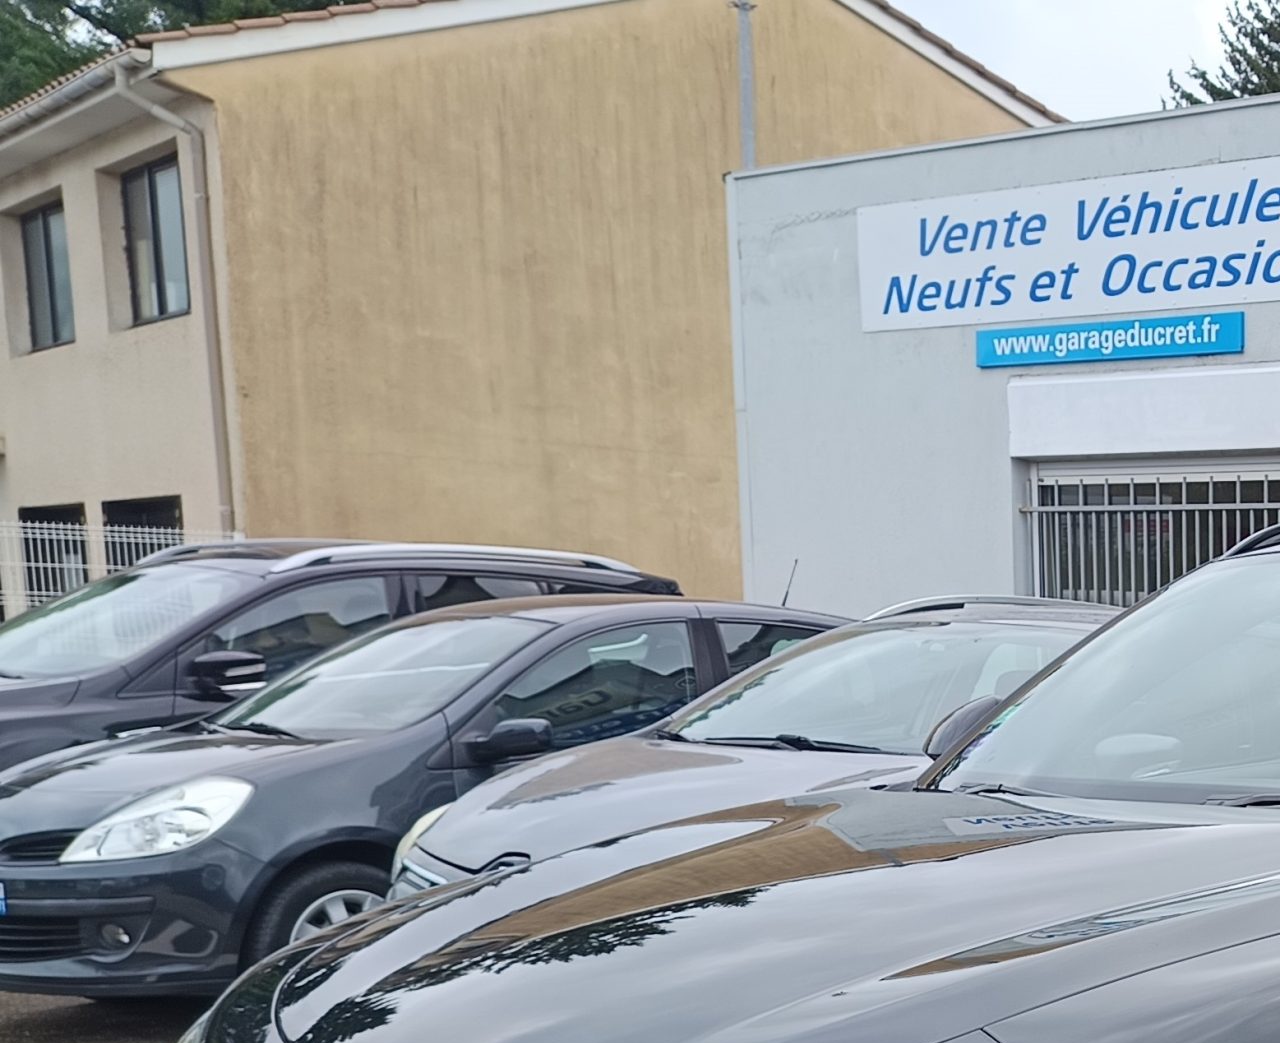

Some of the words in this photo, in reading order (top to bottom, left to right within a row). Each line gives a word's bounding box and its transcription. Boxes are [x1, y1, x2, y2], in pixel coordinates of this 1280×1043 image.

[919, 211, 1047, 257] Vente
[882, 265, 1016, 315] Neufs
[1029, 262, 1079, 302] et
[993, 316, 1220, 357] www.garageducret.fr
